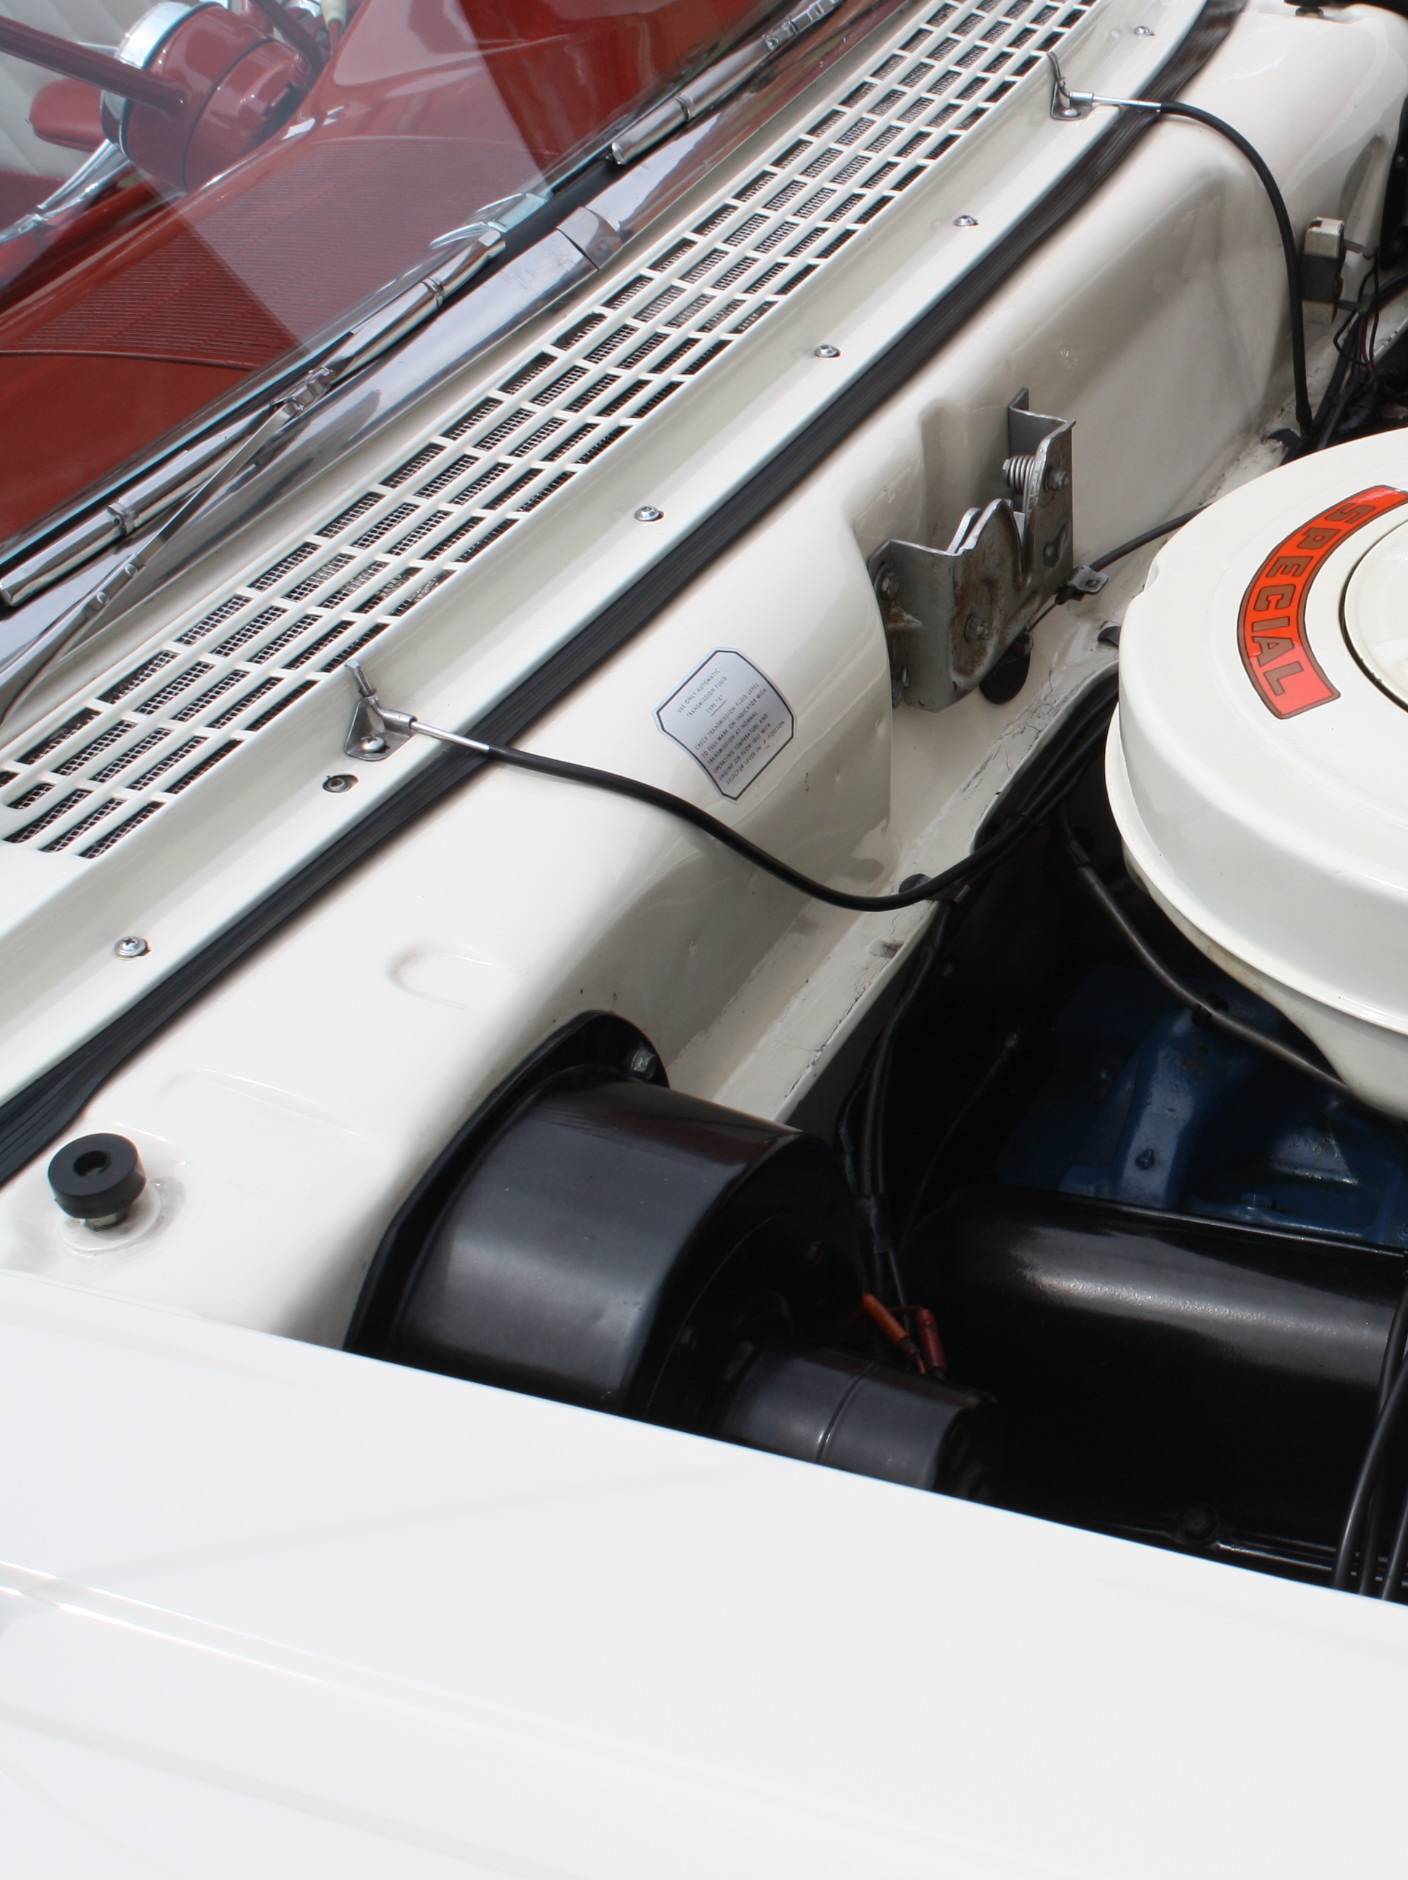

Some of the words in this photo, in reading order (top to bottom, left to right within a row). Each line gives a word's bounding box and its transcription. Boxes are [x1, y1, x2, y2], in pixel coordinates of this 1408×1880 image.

[1248, 500, 1357, 696] SPECIAL
[685, 692, 697, 704] ONLY
[696, 668, 720, 692] AUTOMATIC
[686, 688, 716, 718] TRANSMISSION
[714, 676, 728, 689] FLUID
